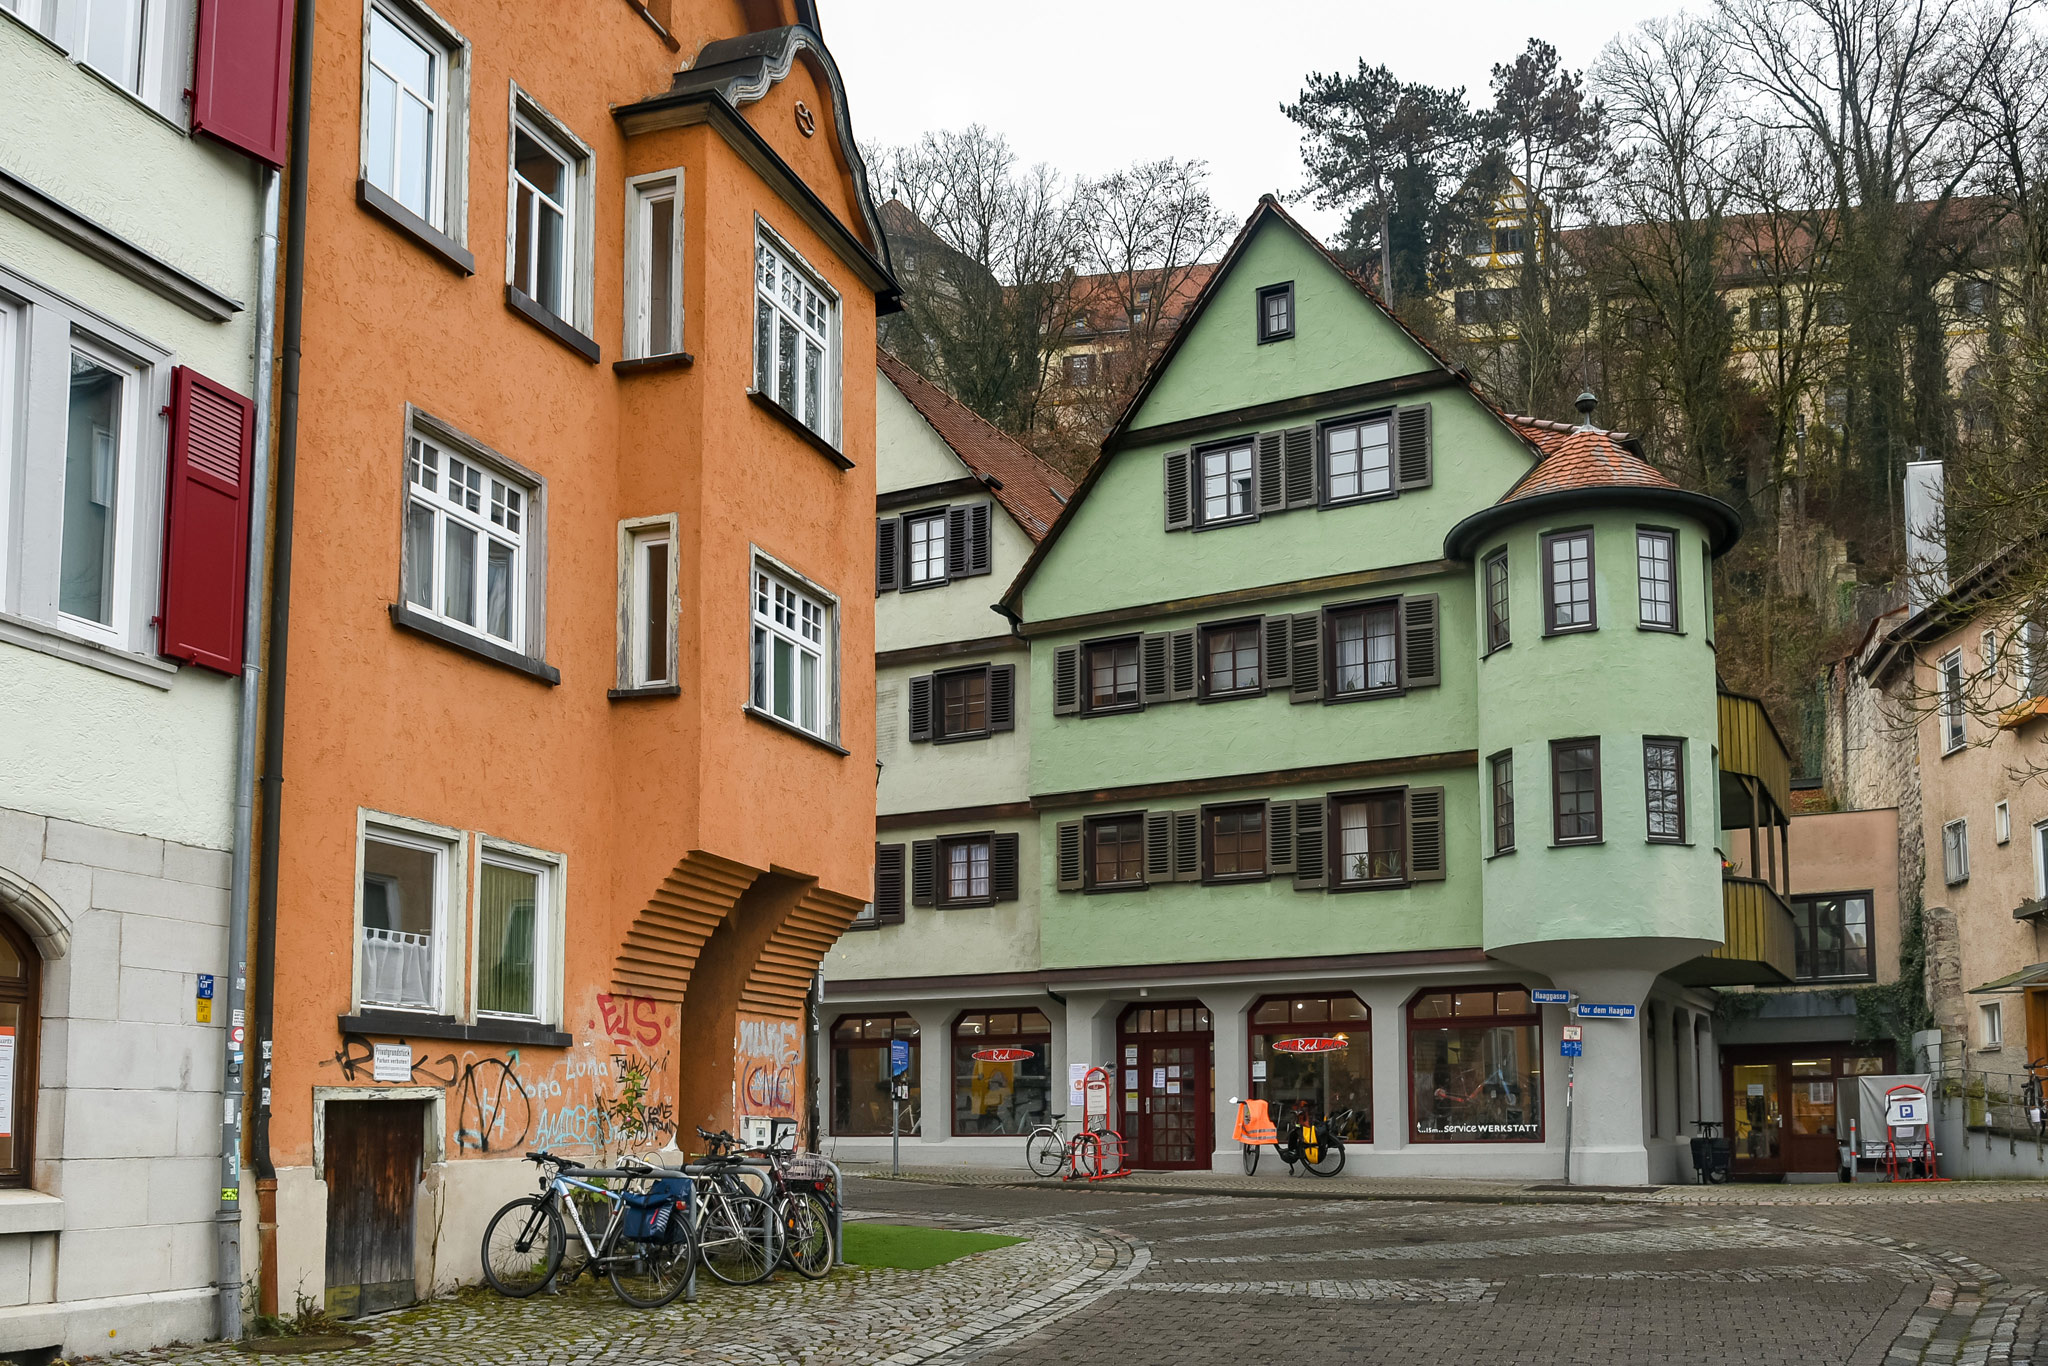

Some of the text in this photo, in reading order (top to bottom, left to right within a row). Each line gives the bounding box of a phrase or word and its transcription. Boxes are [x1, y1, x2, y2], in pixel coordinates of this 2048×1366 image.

[1535, 991, 1567, 1001] Haaggasse
[1580, 1005, 1633, 1017] Vor dem Haagtor
[505, 1056, 609, 1099] Mona Luna
[1444, 1123, 1477, 1133] service
[1478, 1124, 1538, 1133] WERKSTATT
